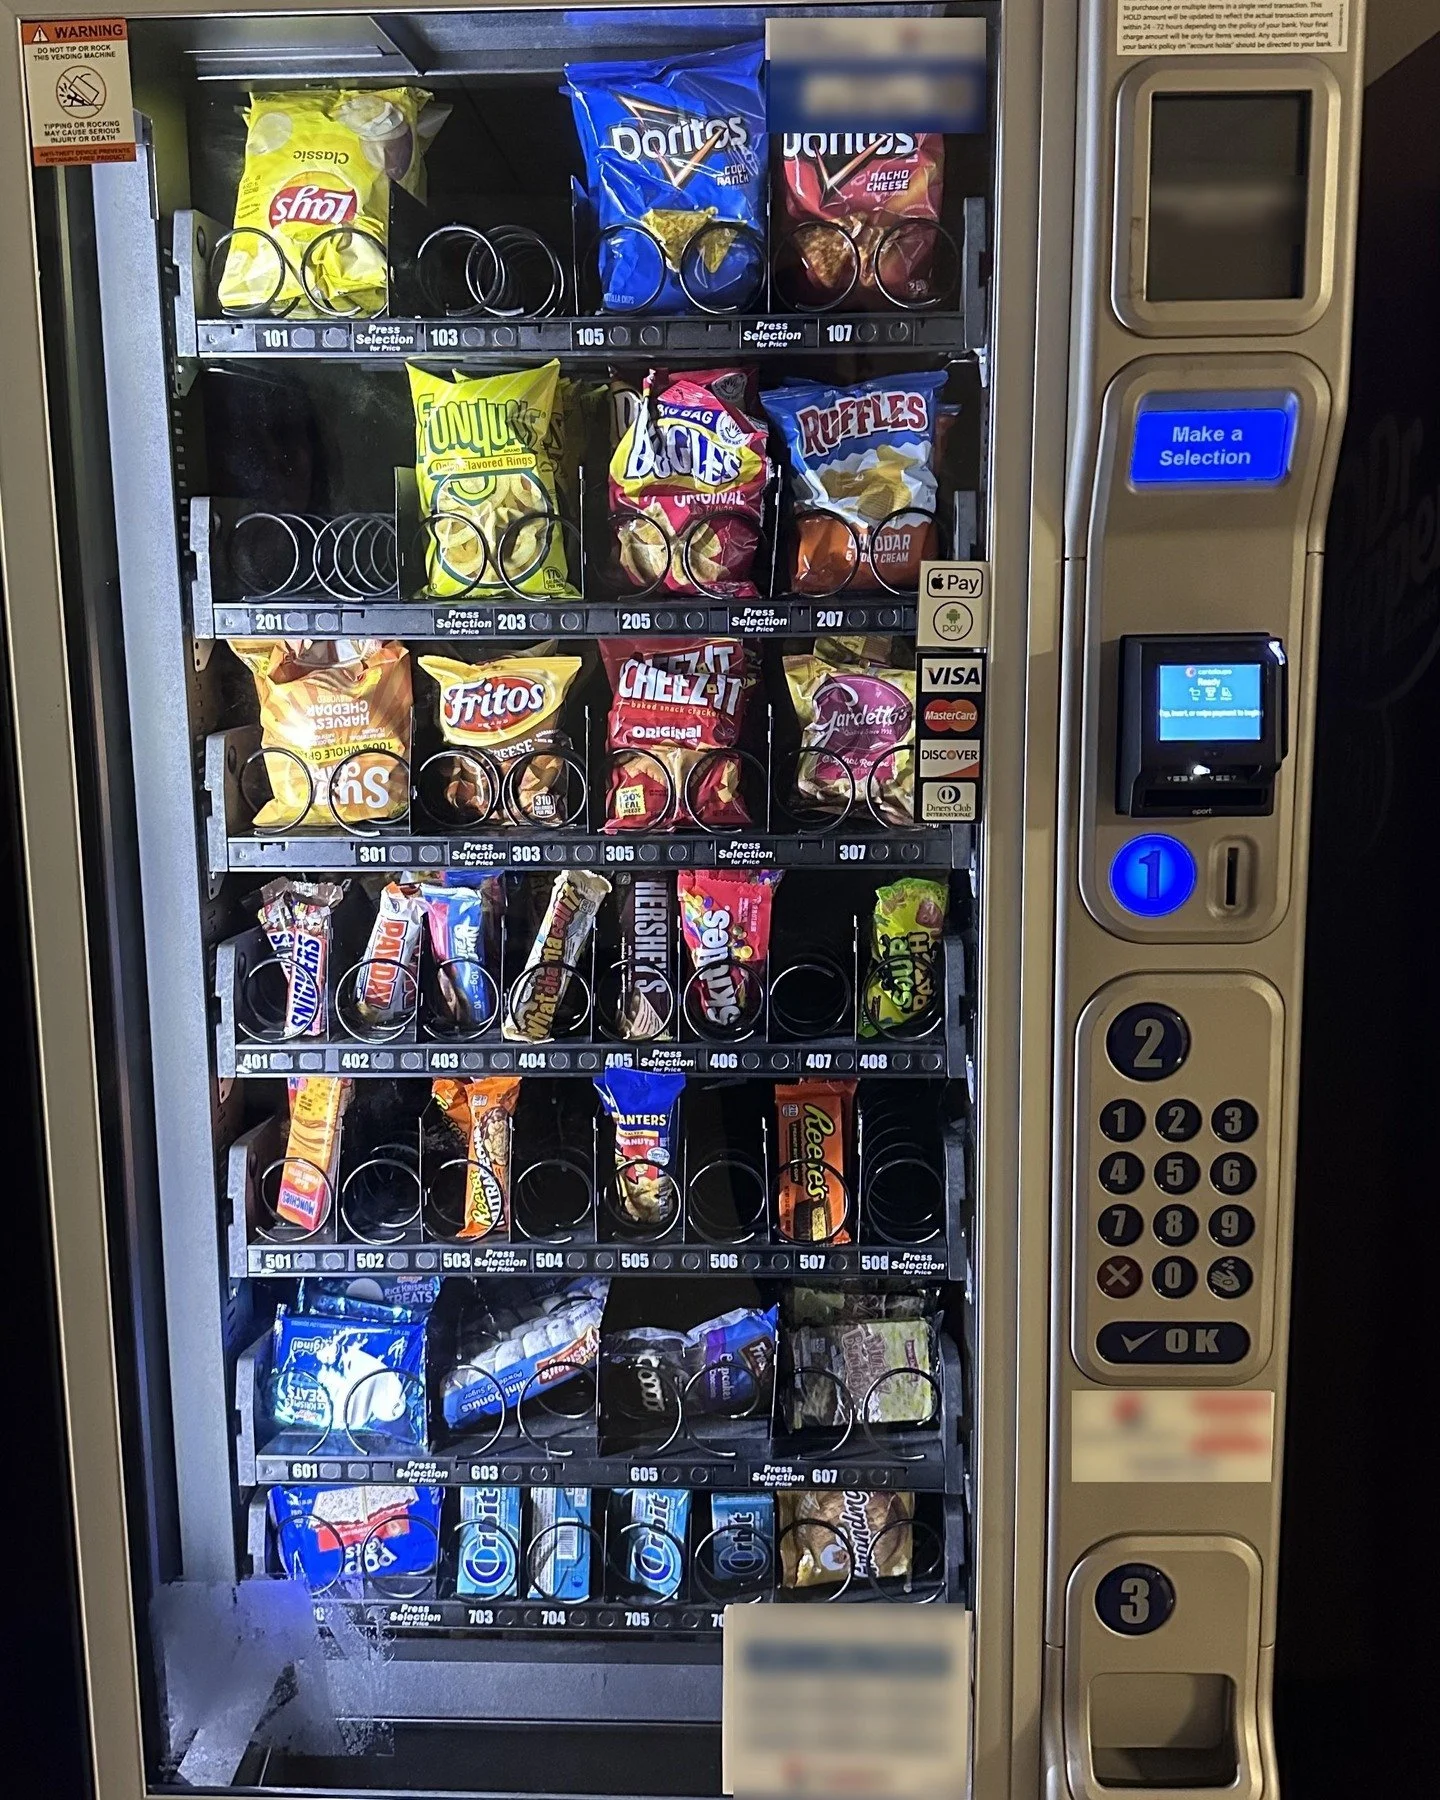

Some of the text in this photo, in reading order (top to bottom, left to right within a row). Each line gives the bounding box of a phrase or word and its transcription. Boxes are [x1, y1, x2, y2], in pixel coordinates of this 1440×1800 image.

[55, 24, 123, 39] WARNING
[84, 51, 116, 59] MACHINE
[91, 44, 111, 52] ROCK
[611, 116, 748, 162] Doritos
[293, 150, 349, 165] Classic
[870, 169, 910, 182] NACHO
[866, 180, 909, 192] CHEESE
[368, 324, 400, 334] Press
[756, 321, 788, 331] Press
[263, 330, 289, 347] 101
[356, 334, 414, 346] Selection
[430, 329, 458, 346] 103
[576, 329, 604, 345] 105
[743, 331, 801, 342] Selection
[826, 326, 853, 342] 107
[796, 391, 928, 458] RUFFLES
[1172, 426, 1243, 443] Make a
[507, 455, 533, 467] Rings
[1159, 449, 1251, 466] Selection
[881, 552, 909, 564] CREAM
[947, 575, 979, 594] Pay
[743, 608, 775, 617] Press
[817, 611, 843, 627] 207
[256, 613, 282, 629] 201
[498, 613, 526, 630] 203
[622, 613, 650, 629] 205
[731, 616, 787, 626] Selection
[942, 624, 963, 634] pay
[924, 666, 981, 685] VISA
[306, 700, 369, 715] CHEDDAR
[442, 678, 546, 727] Fritos
[631, 701, 657, 710] baked
[660, 704, 684, 713] snack
[925, 711, 977, 721] MasterCard
[921, 749, 978, 762] DISCOVER
[535, 795, 552, 806] 310
[926, 802, 972, 813] Diners Club
[606, 845, 634, 861] 305
[729, 841, 761, 850] Press
[839, 844, 866, 861] 307
[360, 846, 386, 862] 301
[512, 846, 540, 862] 303
[718, 849, 773, 859] Selection
[1138, 849, 1161, 900] 1
[1132, 1018, 1165, 1068] 2
[243, 1053, 268, 1069] 401
[341, 1053, 369, 1069] 402
[431, 1053, 458, 1069] 403
[518, 1053, 546, 1069] 404
[605, 1053, 633, 1068] 405
[652, 1049, 683, 1058] Press
[709, 1053, 738, 1068] 406
[640, 1057, 694, 1067] Selection
[806, 1054, 832, 1069] 407
[859, 1054, 888, 1069] 408
[619, 1114, 667, 1126] ANTERS
[1113, 1107, 1126, 1133] 1
[1168, 1107, 1186, 1133] 2
[1224, 1107, 1242, 1134] 3
[1109, 1159, 1128, 1185] 4
[1166, 1159, 1184, 1186] 5
[1222, 1159, 1241, 1187] 6
[282, 1191, 316, 1217] MUNCHIES
[1112, 1210, 1127, 1236] 7
[1165, 1210, 1183, 1237] 8
[1221, 1211, 1239, 1238] 9
[265, 1254, 291, 1269] 501
[357, 1253, 384, 1269] 502
[443, 1253, 470, 1269] 503
[536, 1253, 563, 1268] 504
[621, 1253, 649, 1269] 505
[710, 1253, 738, 1269] 506
[800, 1254, 825, 1269] 507
[862, 1255, 888, 1270] 508
[902, 1252, 933, 1262] Press
[891, 1261, 945, 1271] Selection
[1164, 1262, 1182, 1289] 0
[401, 1283, 434, 1293] KRISPIES
[387, 1291, 433, 1304] TREATS
[1165, 1328, 1220, 1354] OK
[464, 1385, 485, 1400] Sugar
[461, 1391, 501, 1414] Donuts
[292, 1463, 318, 1479] 601
[471, 1465, 499, 1481] 603
[630, 1467, 658, 1482] 605
[812, 1469, 837, 1484] 607
[1120, 1577, 1150, 1624] 3
[468, 1610, 493, 1625] 703
[541, 1610, 566, 1625] 704
[624, 1612, 650, 1627] 705
[711, 1614, 723, 1627] 70
